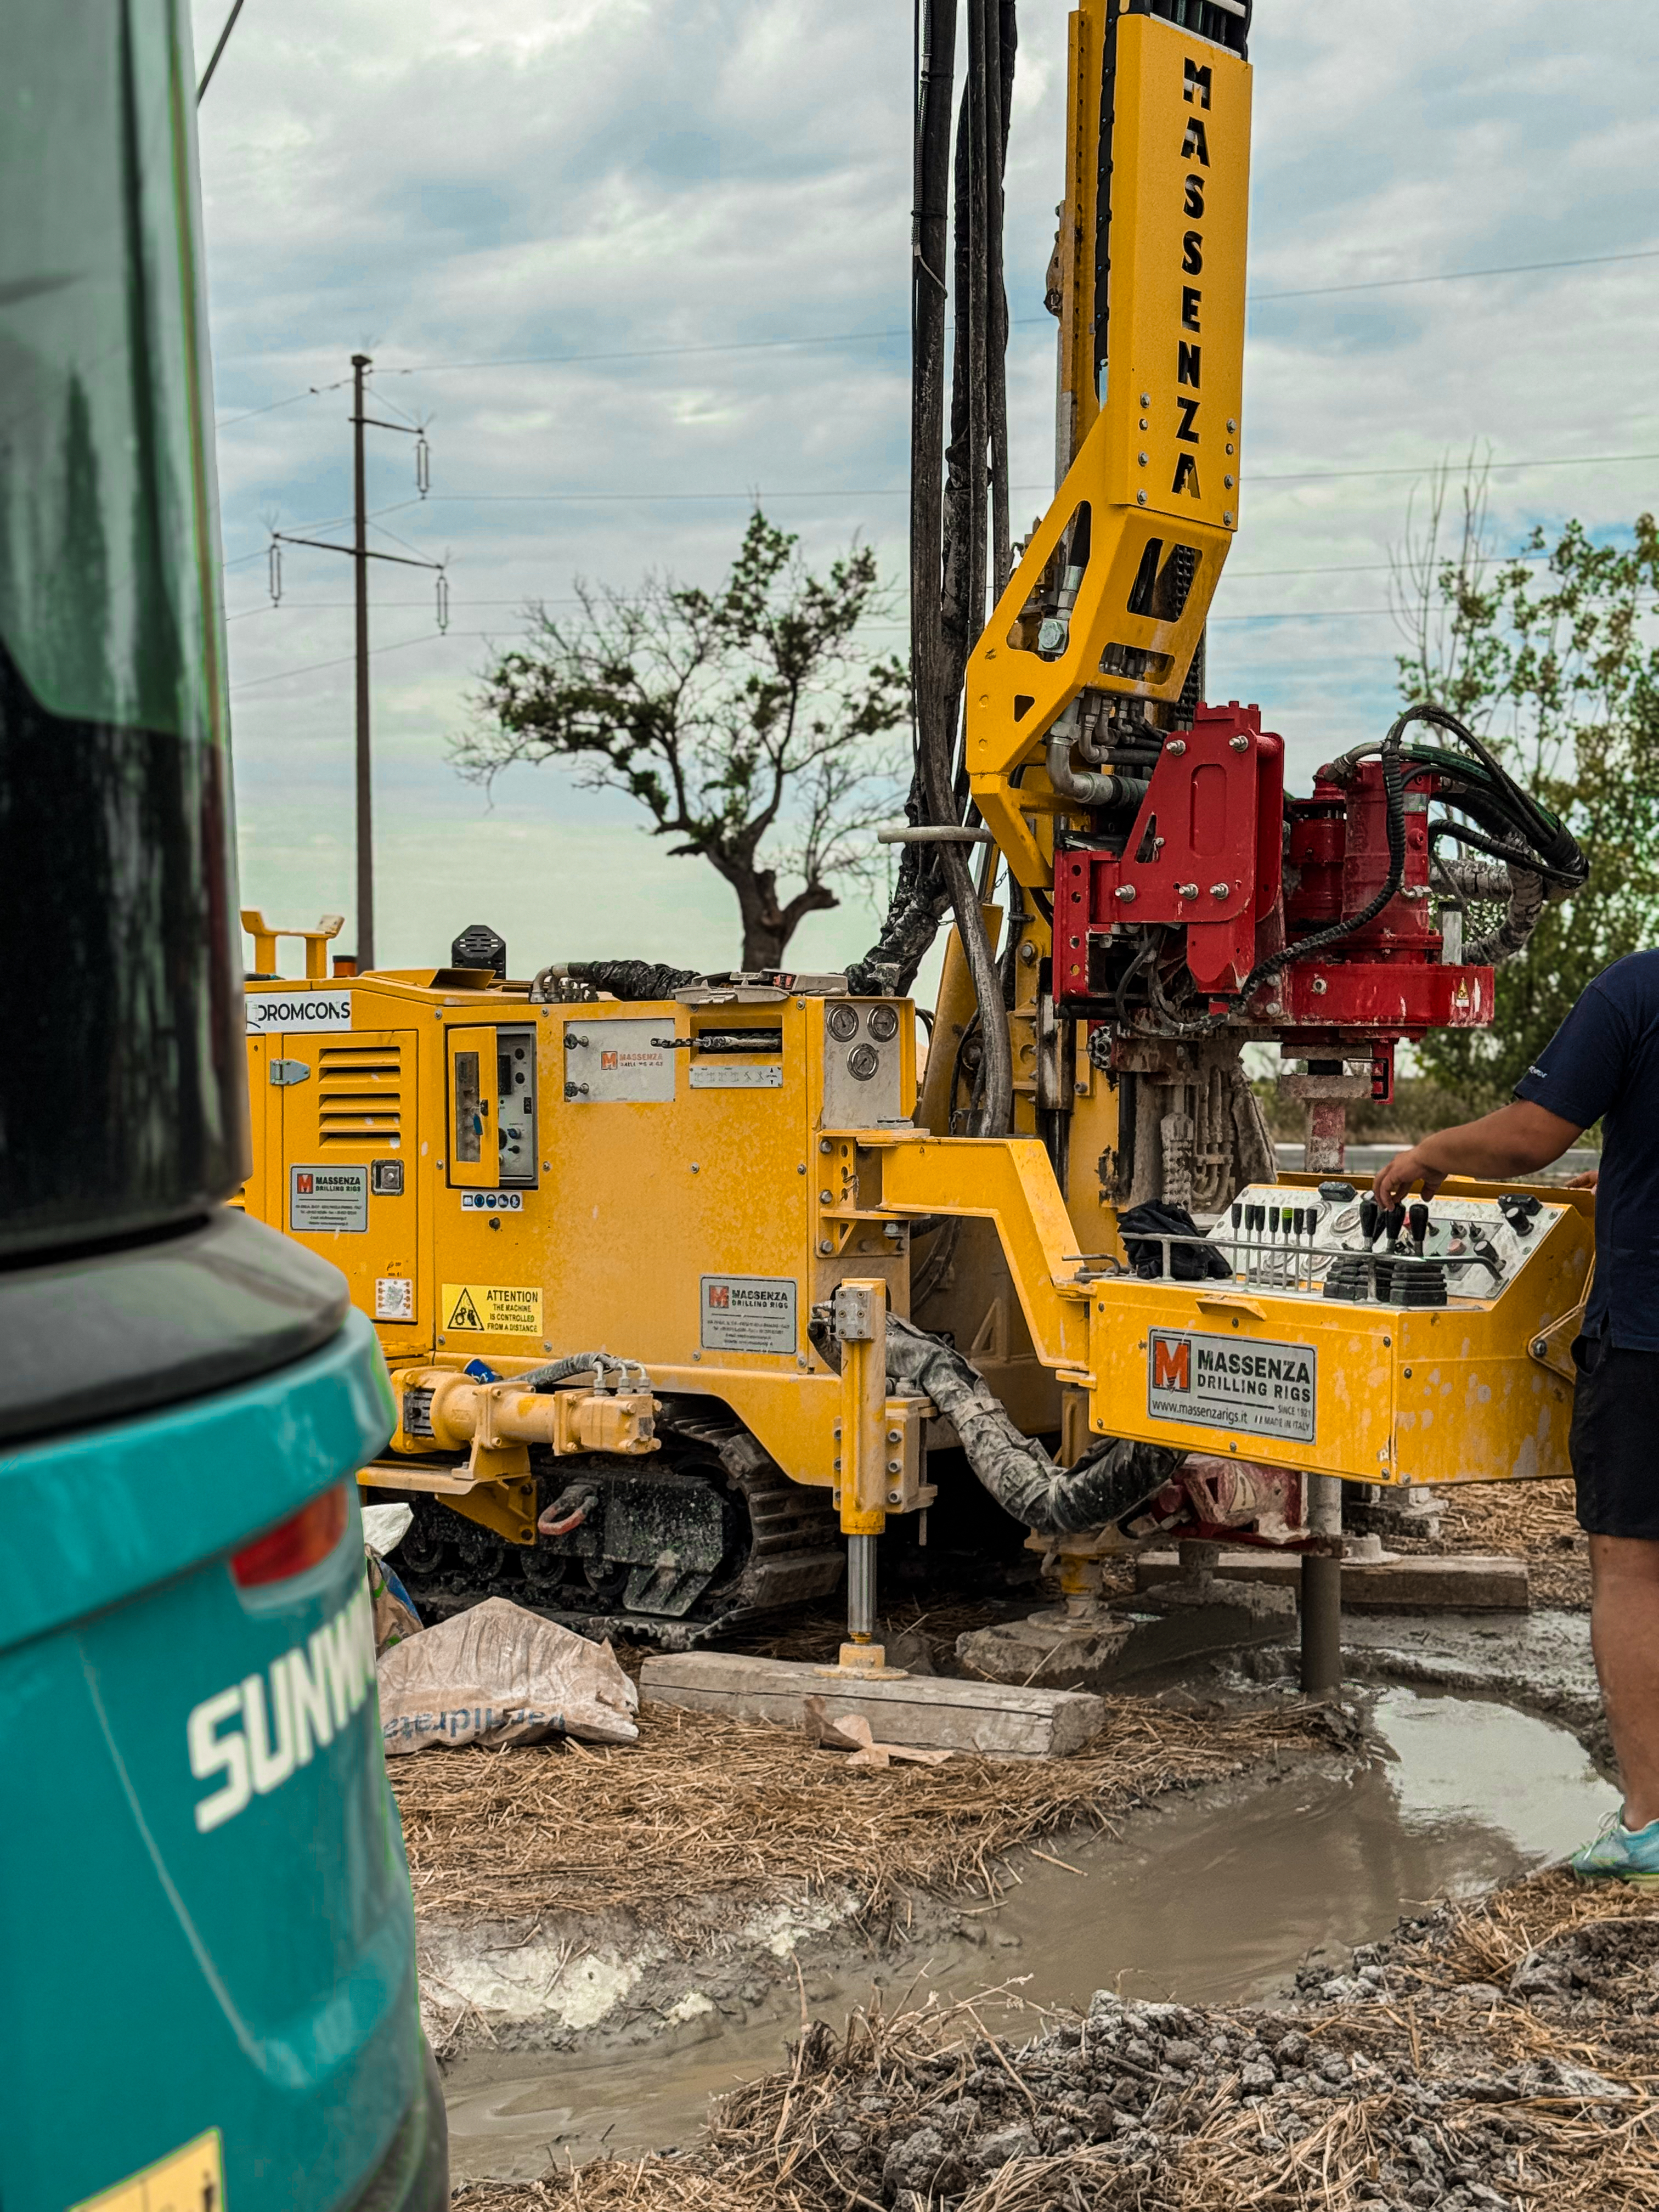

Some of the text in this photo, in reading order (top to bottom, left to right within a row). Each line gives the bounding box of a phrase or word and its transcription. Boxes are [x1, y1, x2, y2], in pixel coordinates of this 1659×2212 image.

[1171, 56, 1212, 500] MASSENZA
[619, 1053, 663, 1061] MASSENZA
[315, 1176, 360, 1185] MASSENZA
[487, 1290, 538, 1303] ATTENTION
[732, 1290, 788, 1301] MASSENZA
[505, 1304, 532, 1313] MACHINE
[496, 1313, 535, 1323] CONTROLLED
[509, 1323, 538, 1333] DISTANCE
[1154, 1339, 1189, 1391] M
[1198, 1349, 1311, 1385] MASSENZA
[1197, 1374, 1311, 1403] DRILLING RIGS
[1152, 1400, 1248, 1425] www.massenzarigs.it
[1278, 1404, 1295, 1415] SINCE
[1264, 1416, 1283, 1427] MADE
[1293, 1420, 1310, 1431] ITALY
